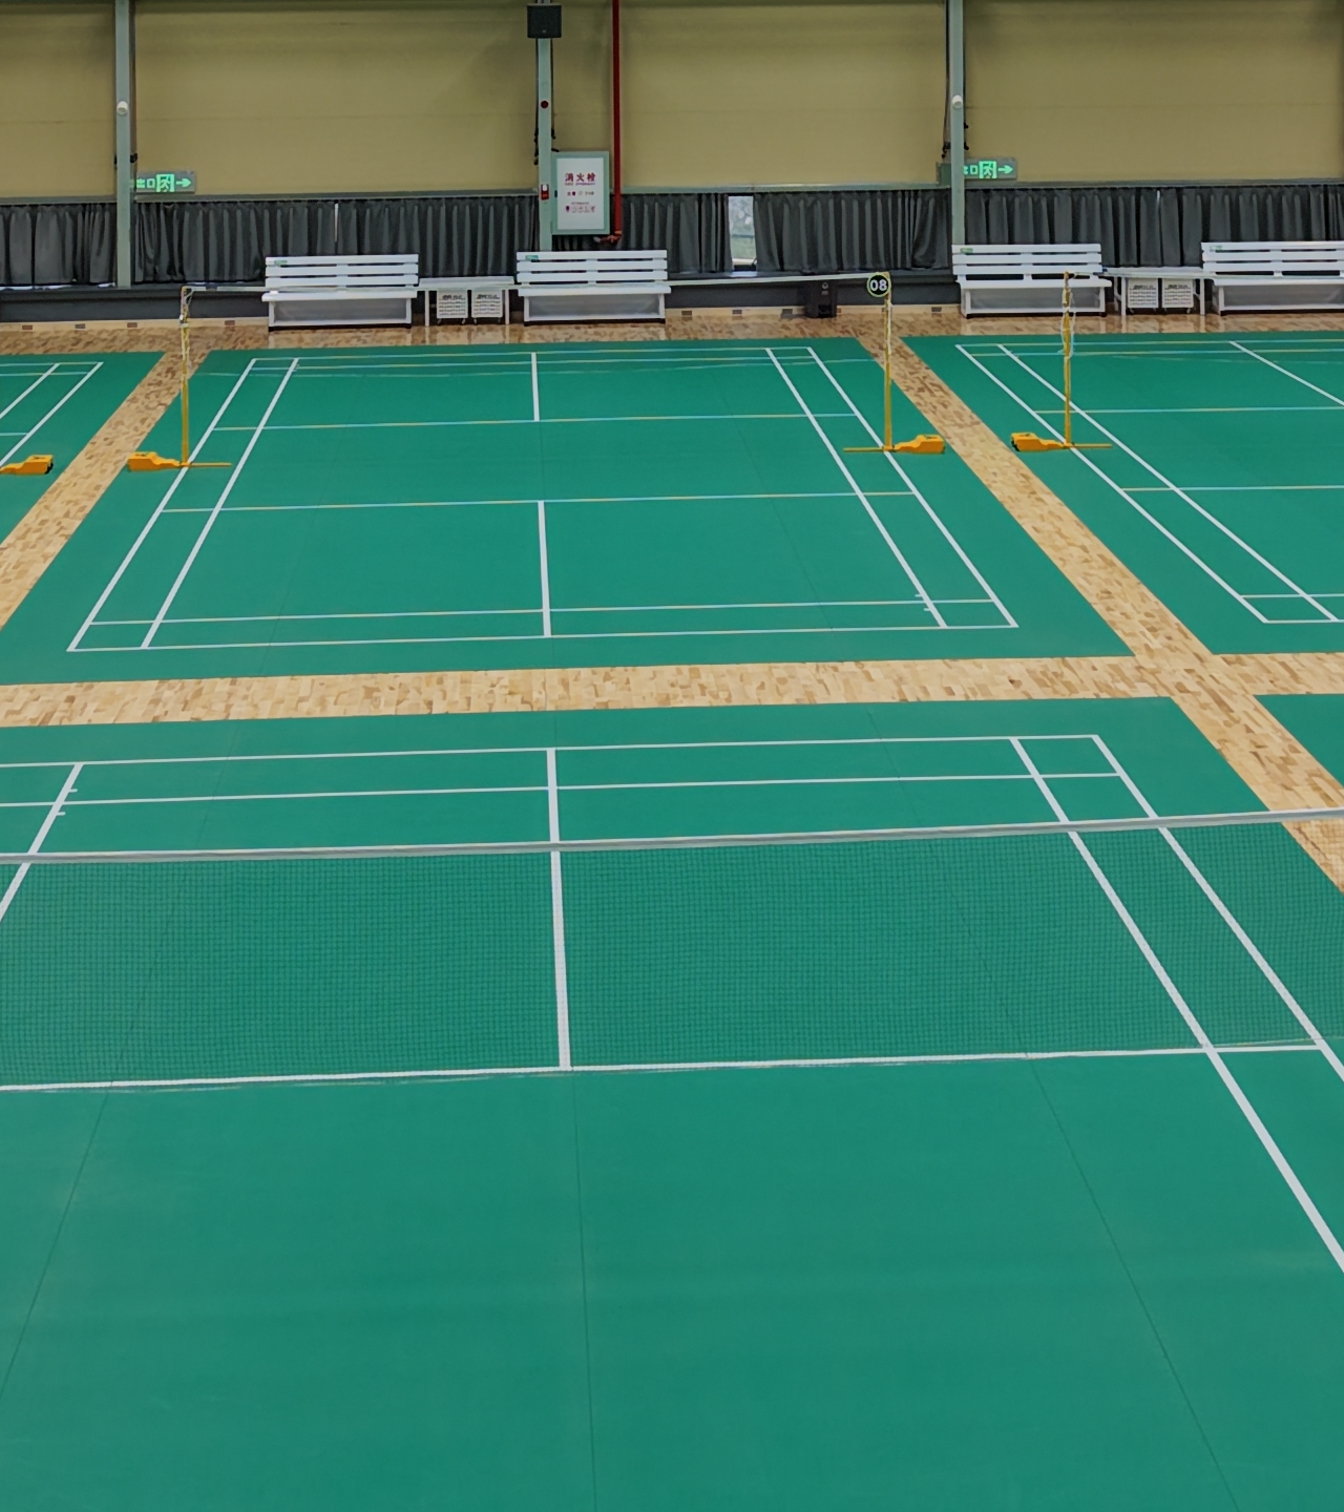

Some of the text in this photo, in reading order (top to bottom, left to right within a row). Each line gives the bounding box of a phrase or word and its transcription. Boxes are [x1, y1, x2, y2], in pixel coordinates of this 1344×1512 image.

[565, 172, 596, 182] 消火栓
[870, 279, 888, 292] 08
